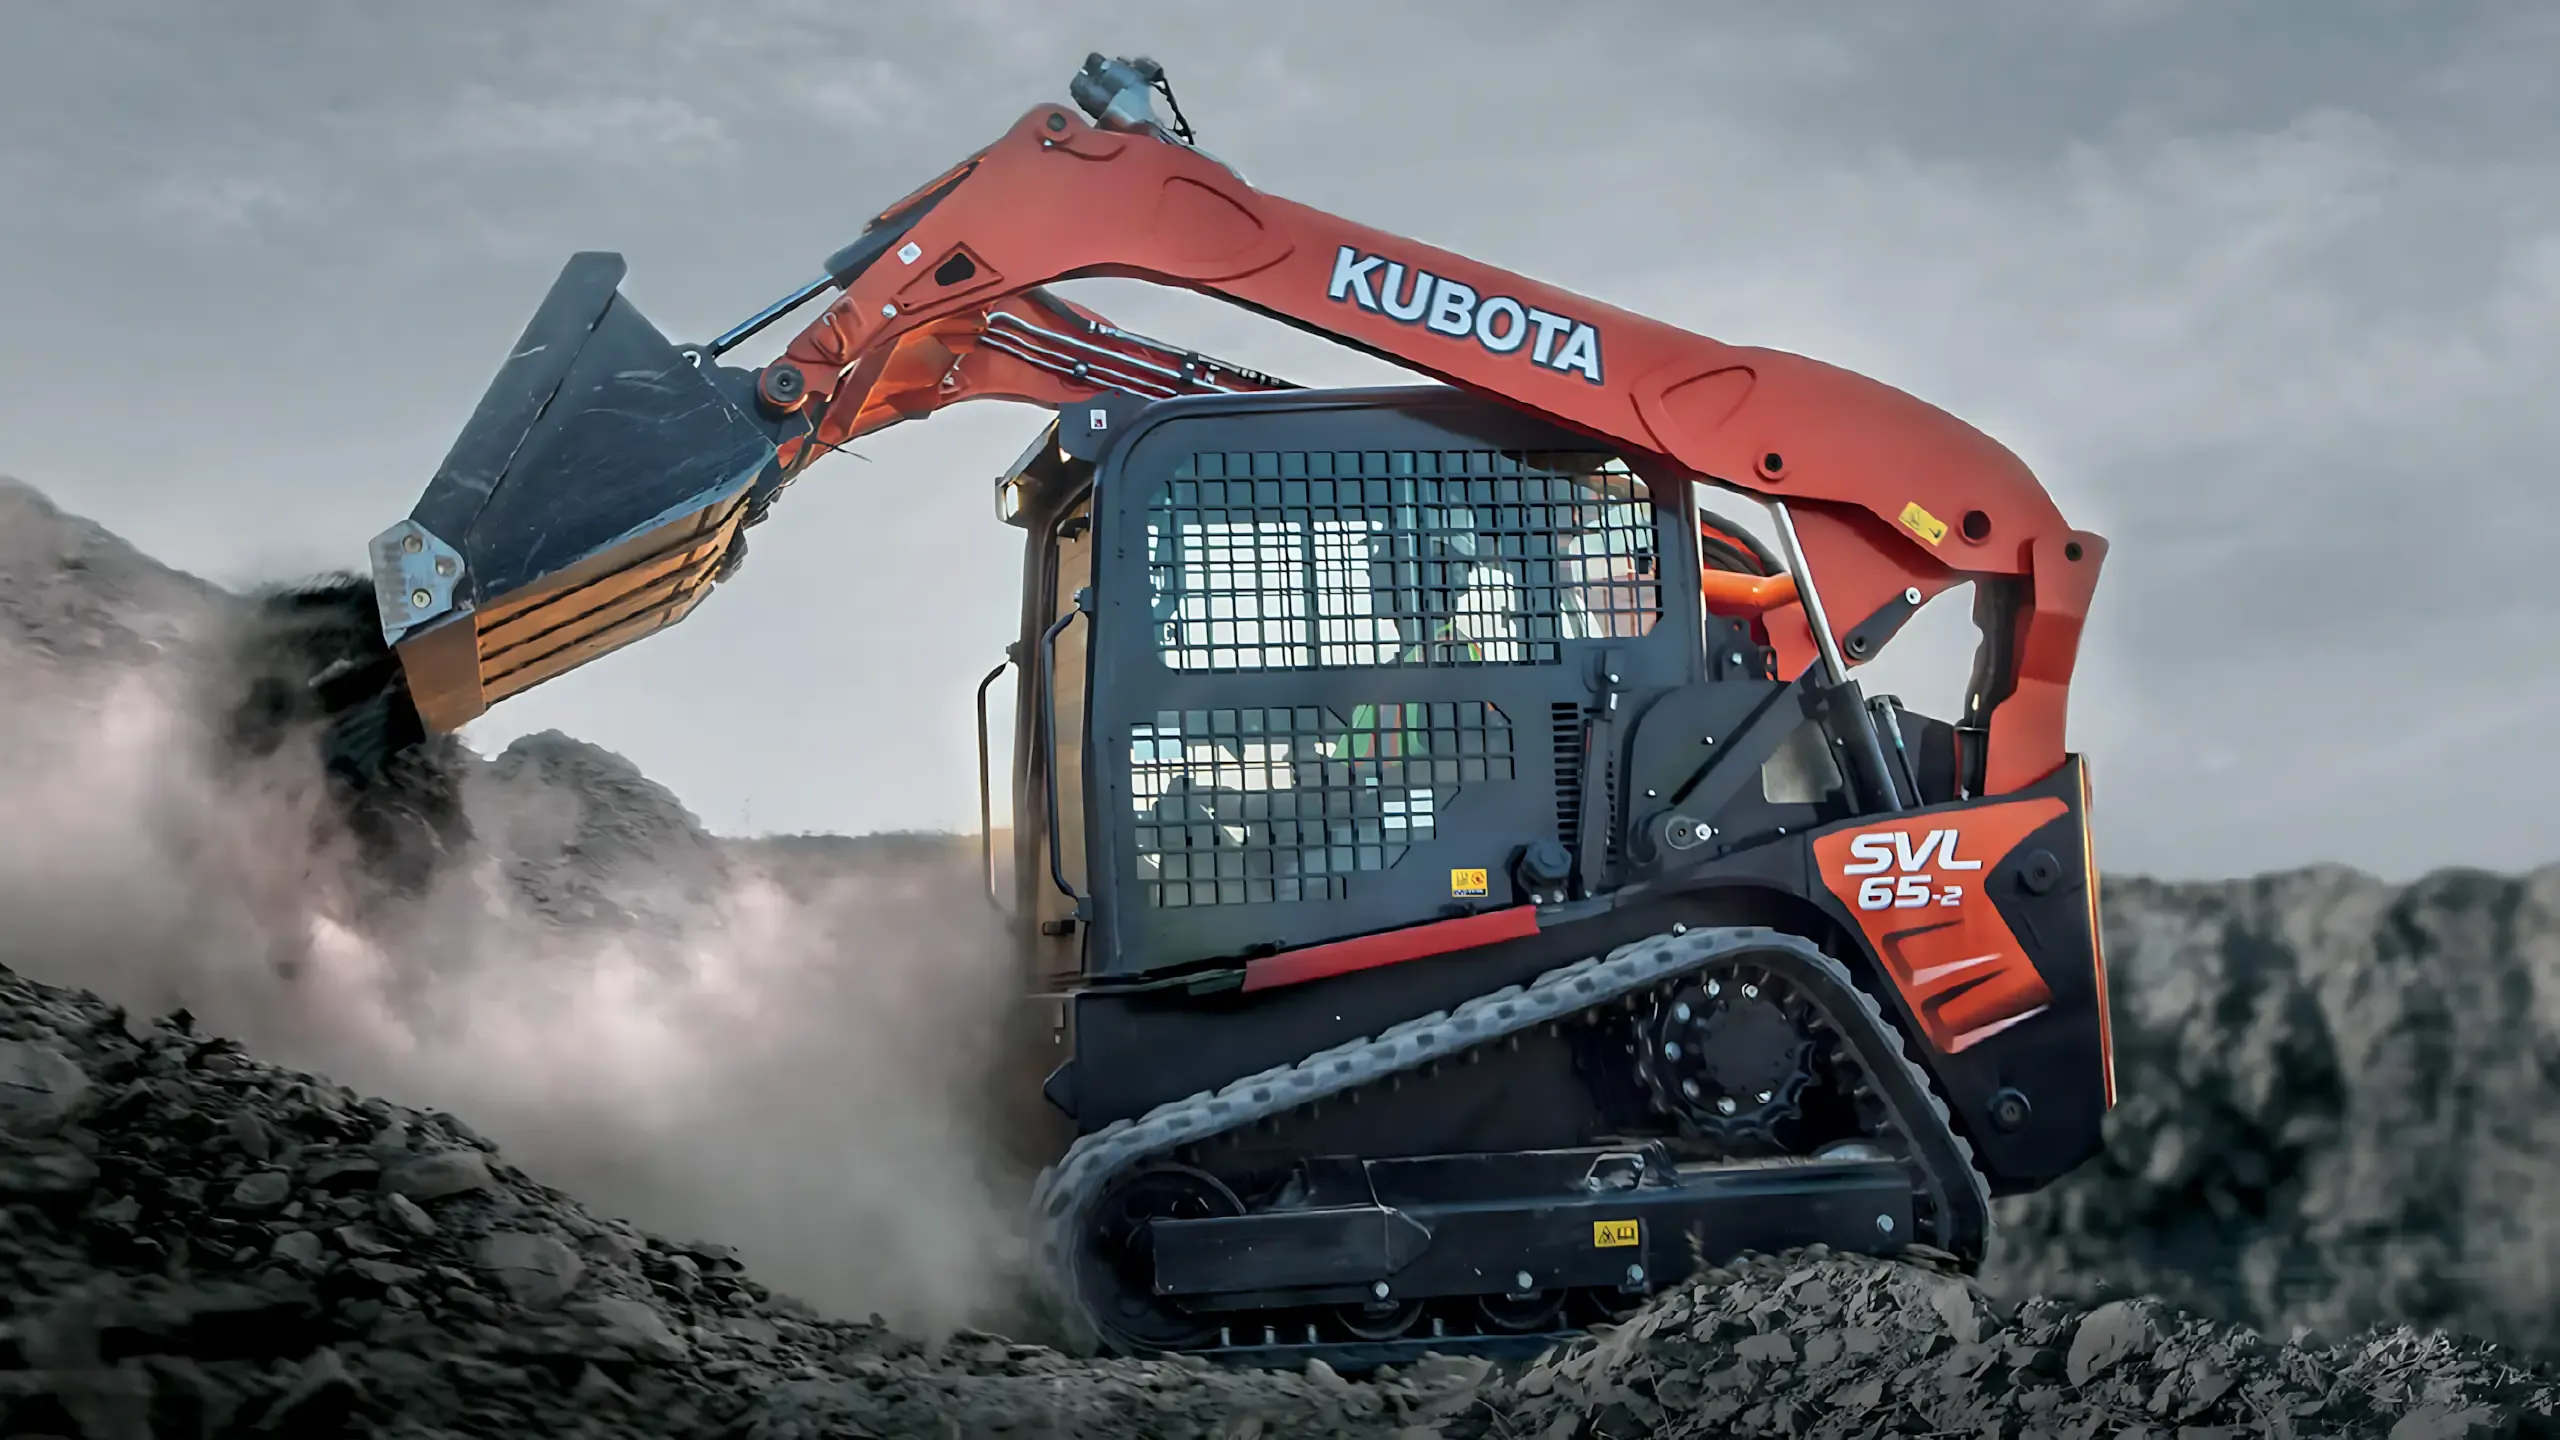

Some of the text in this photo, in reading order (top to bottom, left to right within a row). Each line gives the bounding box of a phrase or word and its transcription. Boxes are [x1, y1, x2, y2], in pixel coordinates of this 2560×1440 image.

[1327, 245, 1604, 385] KUBOTA
[1844, 829, 1982, 875] SVL
[1858, 874, 1963, 910] 65-2
